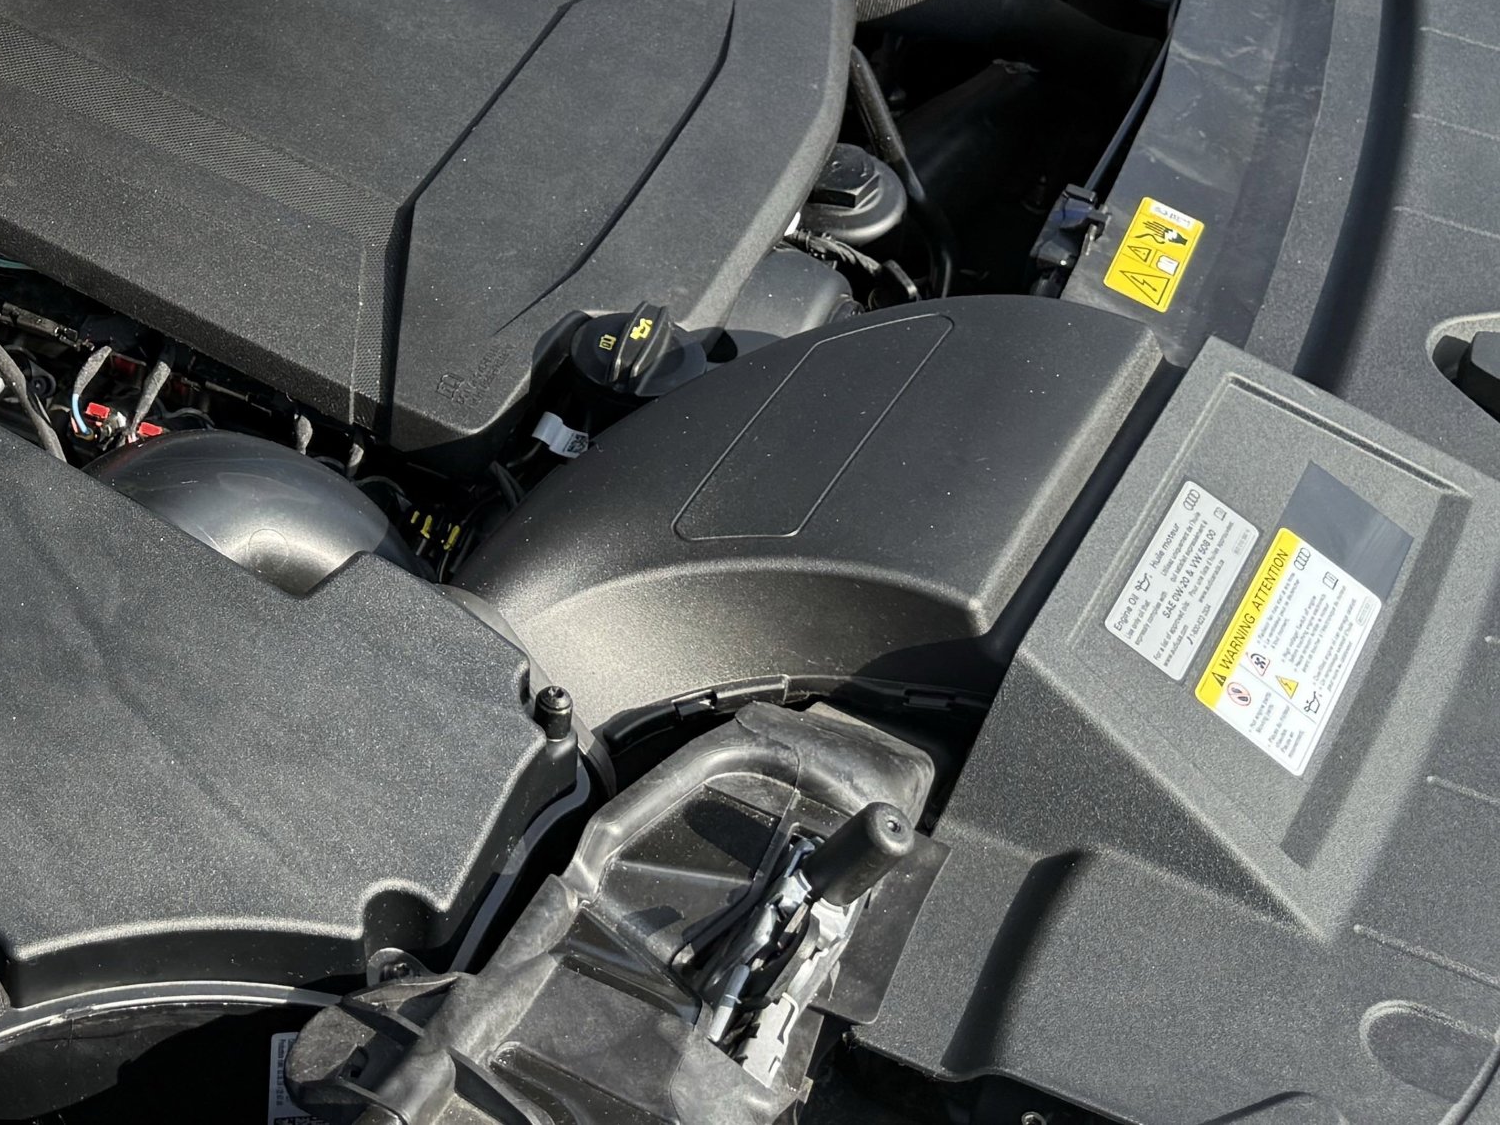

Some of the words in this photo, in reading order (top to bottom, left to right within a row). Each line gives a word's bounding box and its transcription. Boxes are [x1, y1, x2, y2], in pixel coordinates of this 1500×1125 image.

[1148, 547, 1166, 570] Huile
[1159, 521, 1181, 551] moteur
[1161, 599, 1176, 619] SAE
[1170, 575, 1190, 603] 0W-20
[1184, 567, 1194, 578] &
[1189, 551, 1203, 570] VW
[1197, 538, 1211, 555] 508
[1205, 527, 1216, 541] 00
[1112, 603, 1135, 634] Engine
[1126, 591, 1140, 607] Oil
[1220, 613, 1256, 671] WARNING
[1252, 548, 1288, 612] ATTENTION
